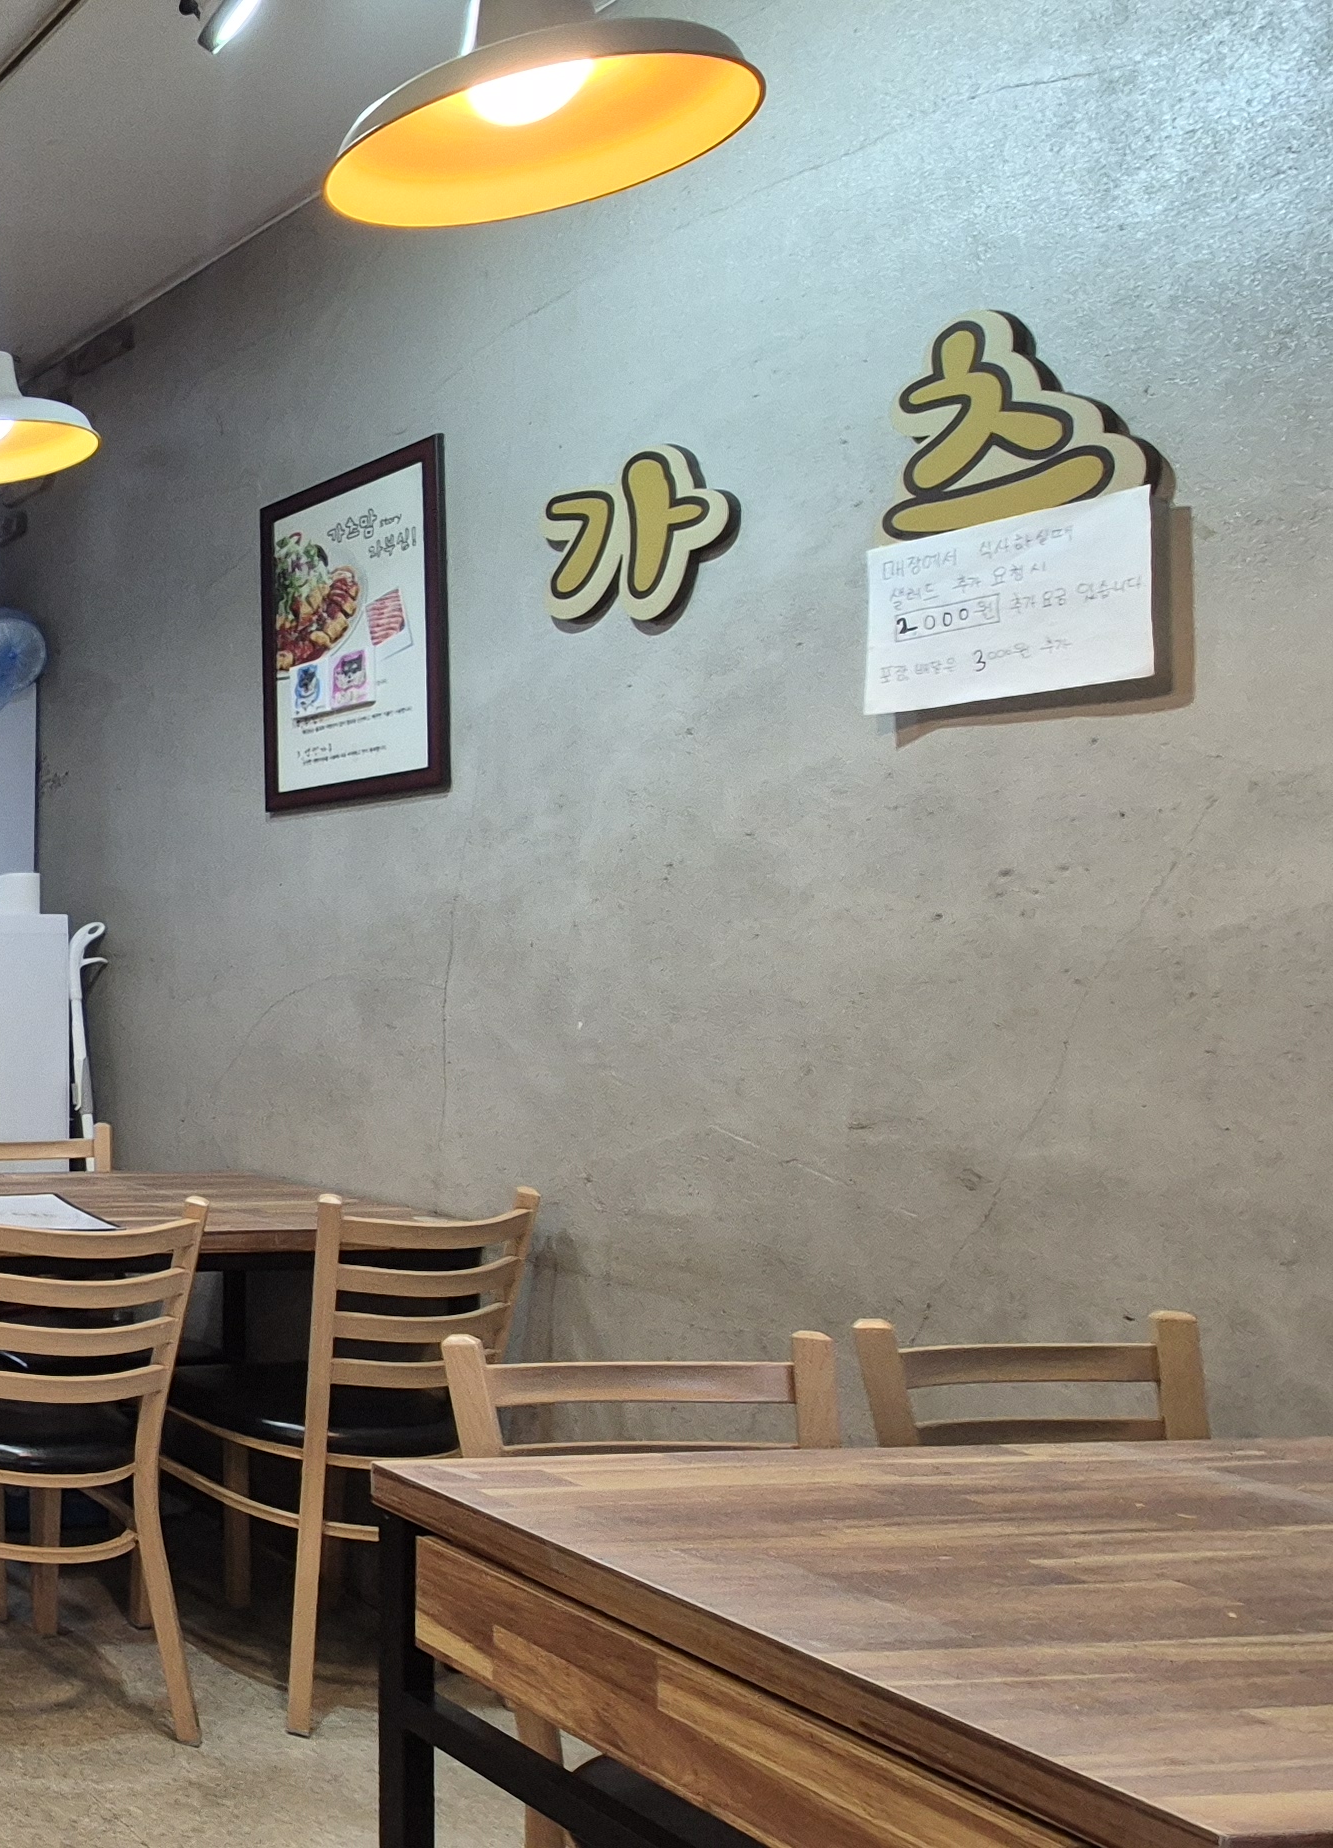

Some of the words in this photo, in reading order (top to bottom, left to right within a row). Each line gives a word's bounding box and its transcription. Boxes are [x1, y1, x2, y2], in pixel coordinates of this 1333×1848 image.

[327, 508, 377, 543] 가츠맘
[542, 446, 721, 612] 가
[883, 549, 957, 580] 매장에서
